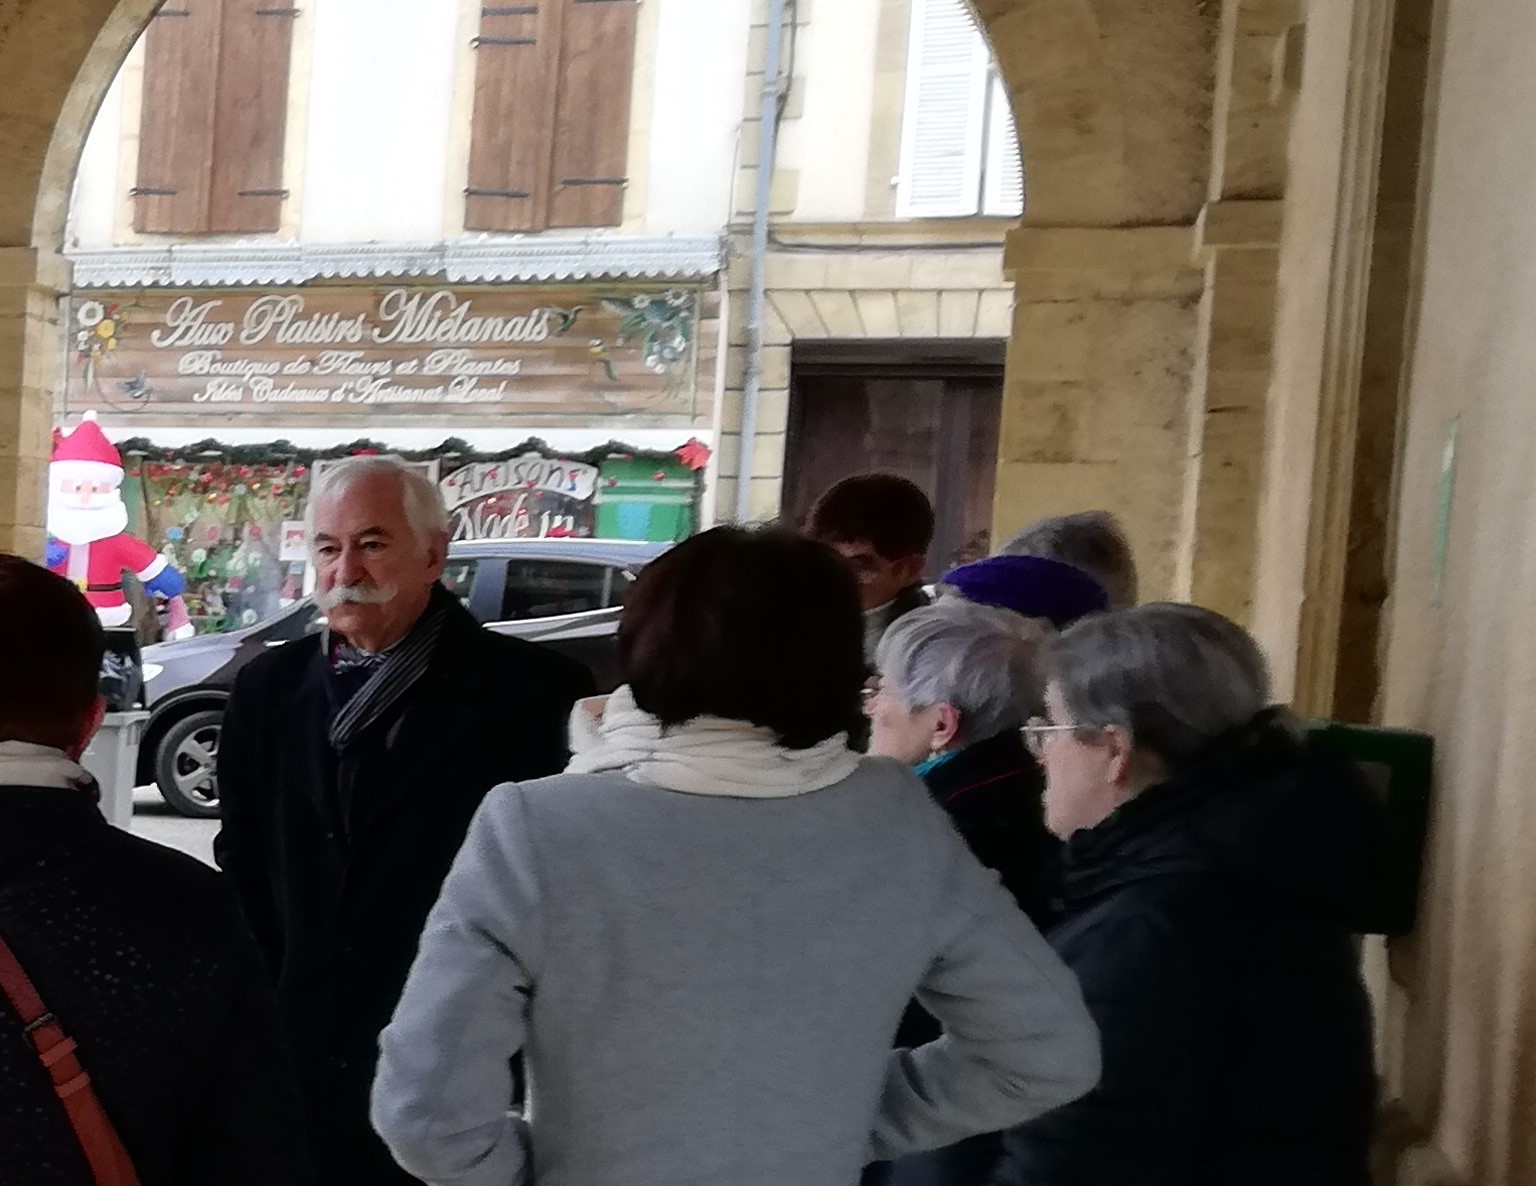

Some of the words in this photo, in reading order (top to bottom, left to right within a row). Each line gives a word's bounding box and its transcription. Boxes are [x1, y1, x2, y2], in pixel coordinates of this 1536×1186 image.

[150, 296, 234, 348] Aux
[239, 294, 367, 345] Plaisirs
[177, 349, 280, 382] Boutique
[282, 354, 311, 375] de
[312, 350, 394, 376] Fleurs
[394, 357, 420, 375] et
[422, 348, 523, 376] Plantes
[249, 376, 330, 402] Cadeaux
[446, 375, 509, 404] Local
